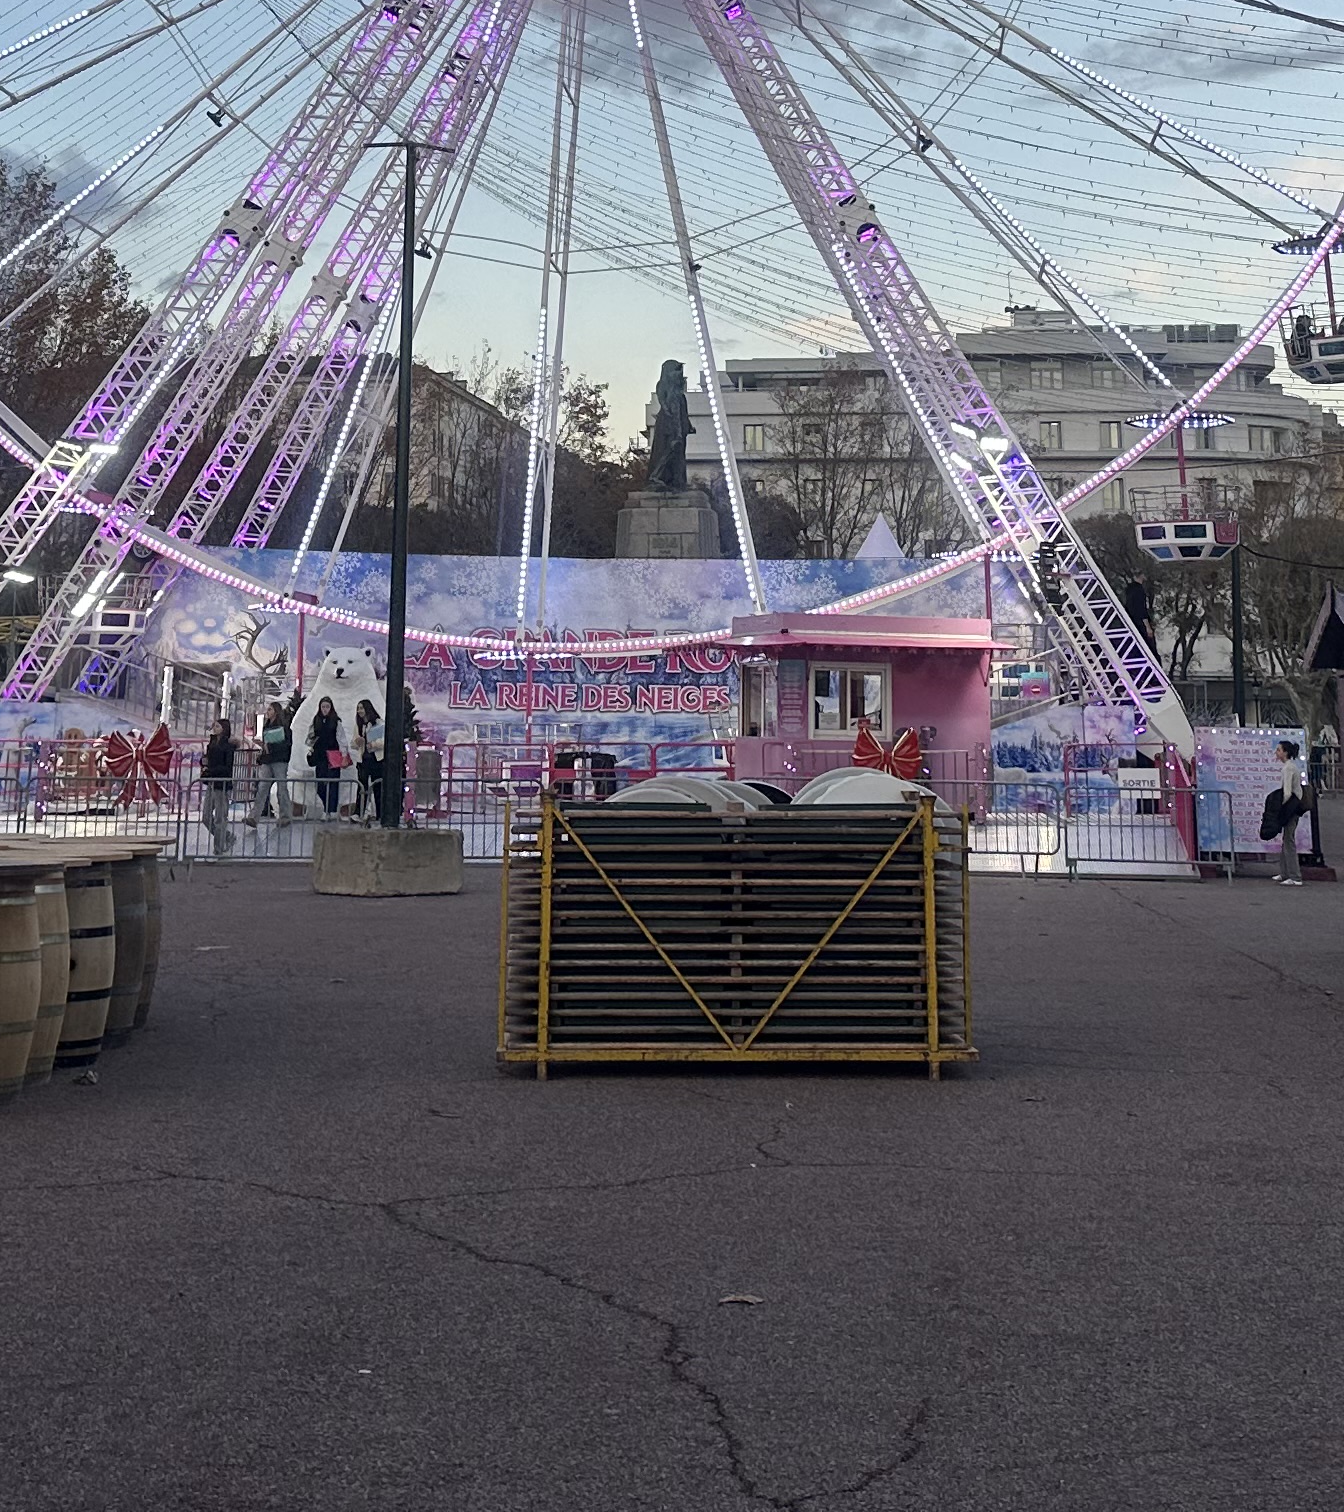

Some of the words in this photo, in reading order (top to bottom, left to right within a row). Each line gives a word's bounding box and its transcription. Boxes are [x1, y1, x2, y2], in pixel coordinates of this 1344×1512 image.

[666, 631, 741, 674] RO
[450, 681, 490, 710] LA
[496, 682, 578, 712] REINE
[582, 684, 632, 712] DES
[636, 685, 732, 714] NEIGES
[1122, 779, 1156, 787] SORTIE
